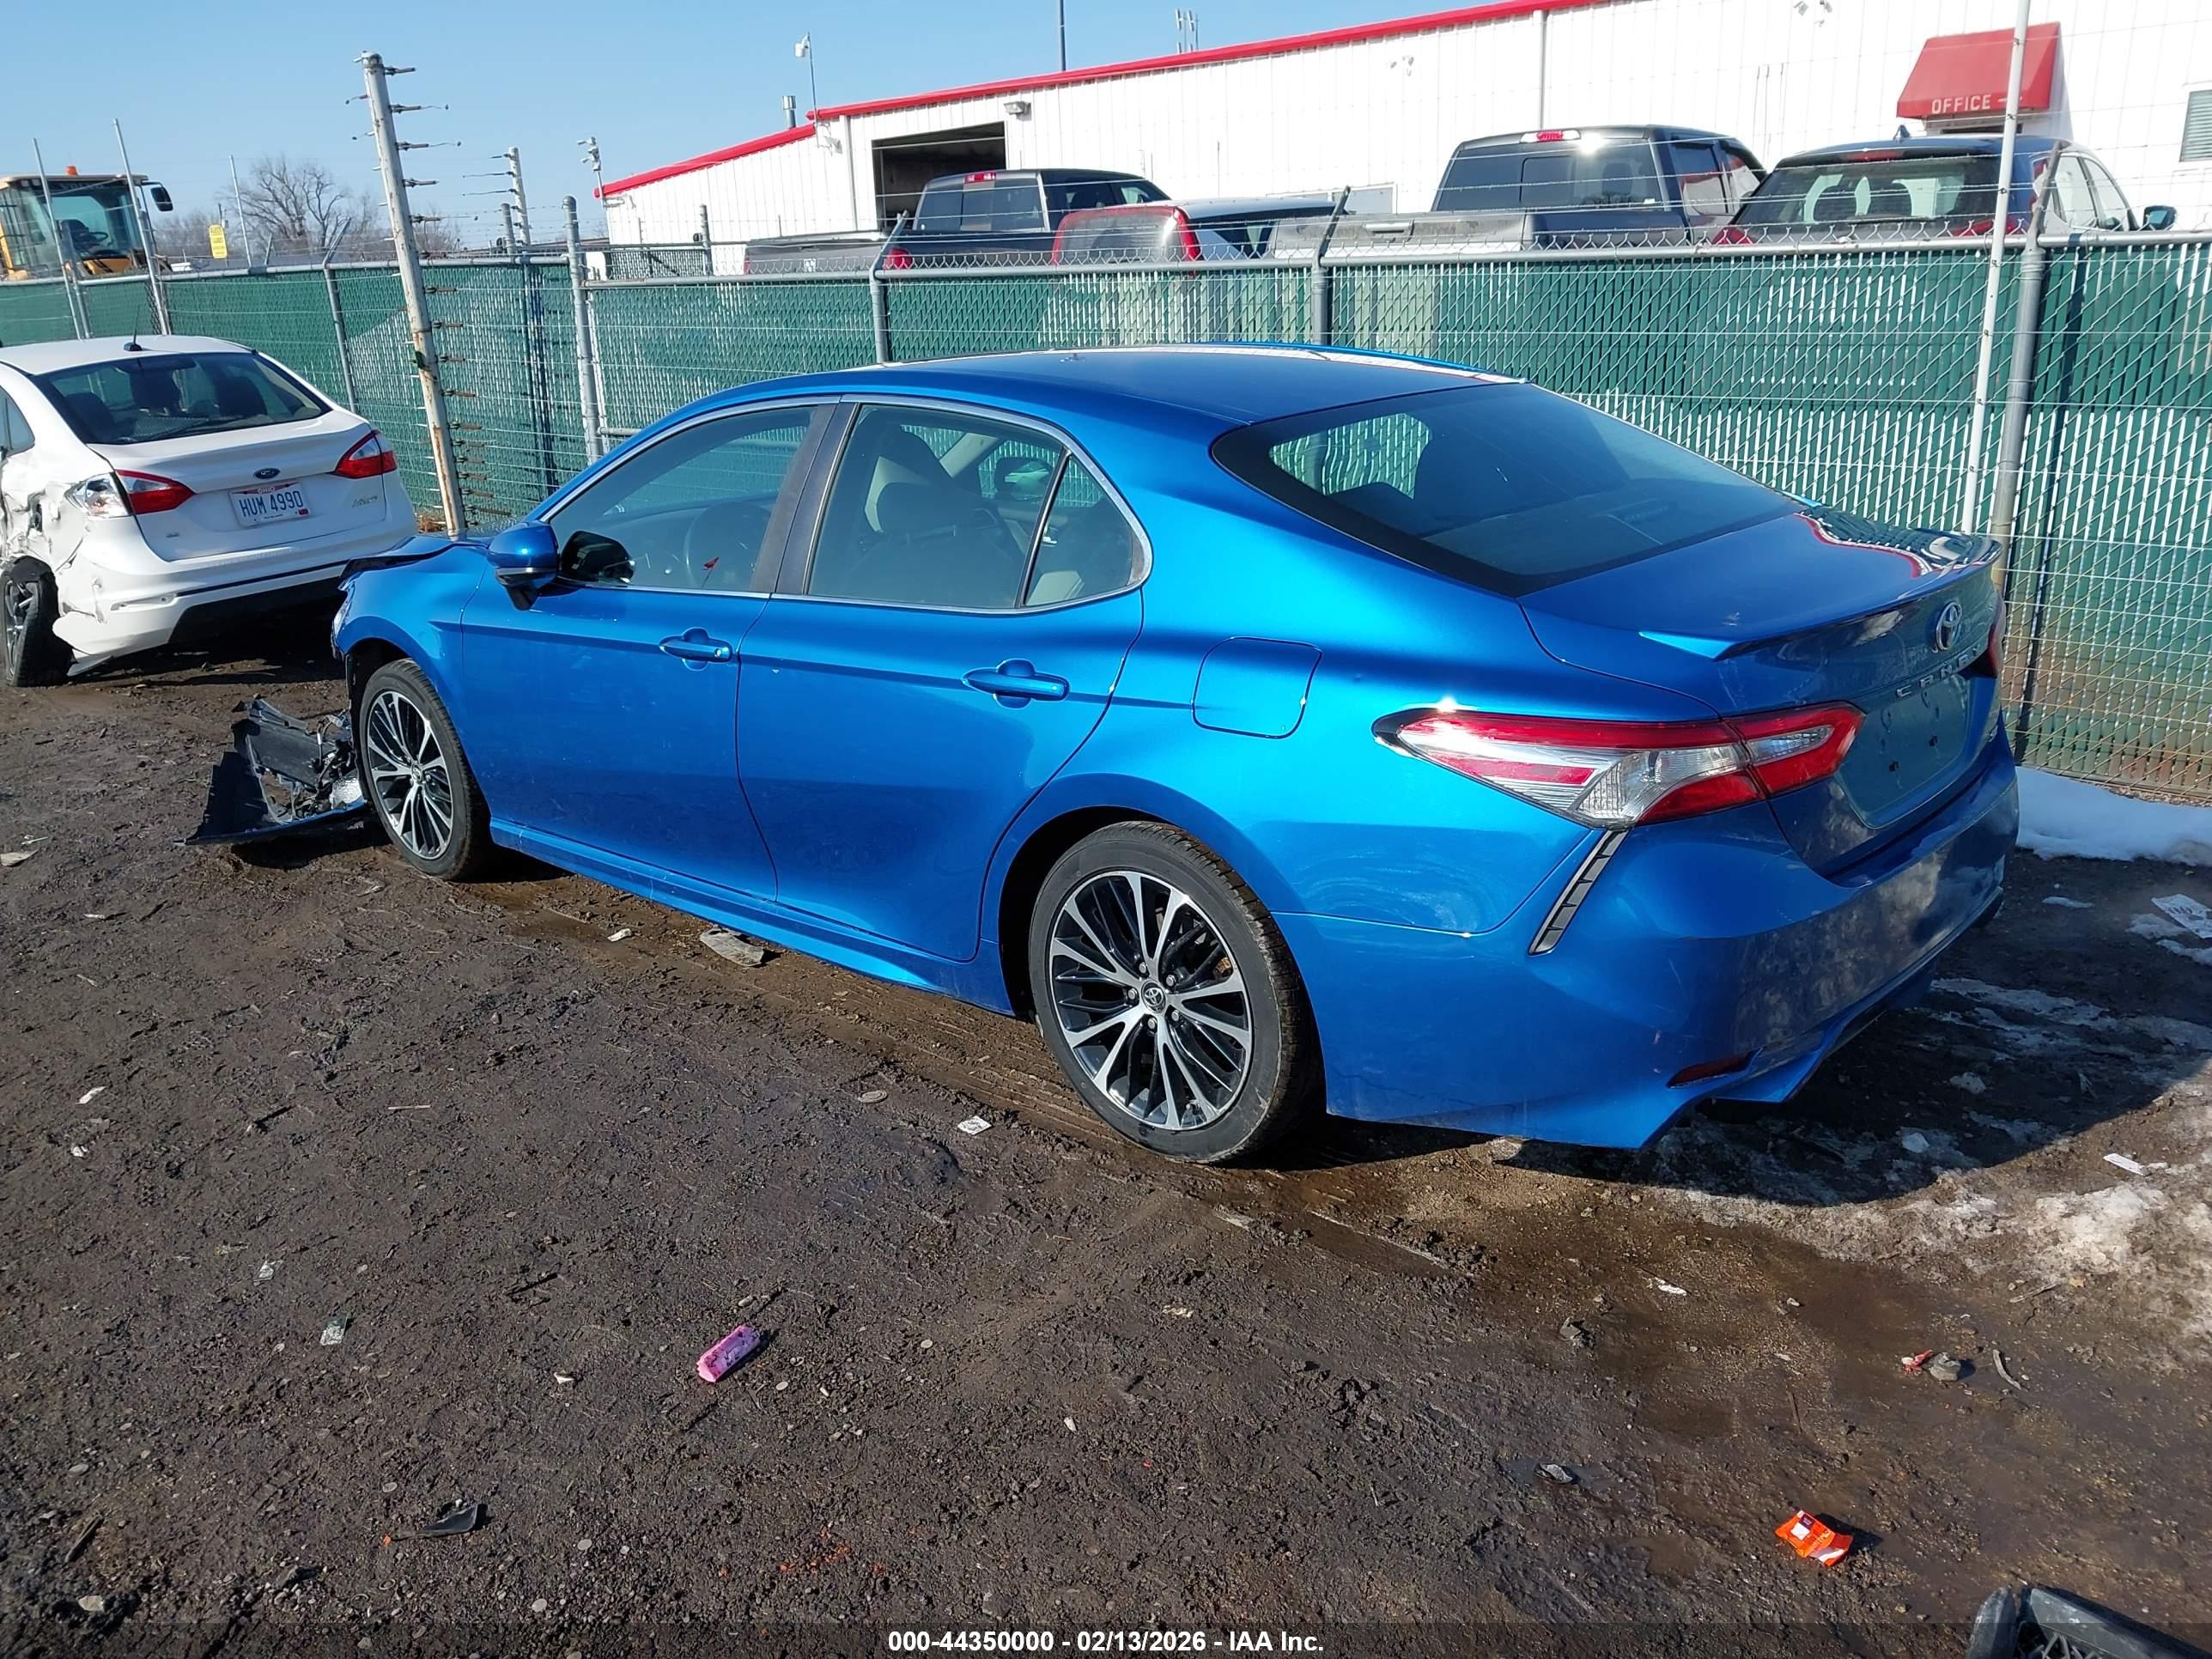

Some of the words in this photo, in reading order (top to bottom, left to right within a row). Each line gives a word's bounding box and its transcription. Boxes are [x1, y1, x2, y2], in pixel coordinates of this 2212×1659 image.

[1931, 94, 1991, 114] OFFICE
[239, 495, 267, 517] HUM
[270, 490, 304, 512] 4990
